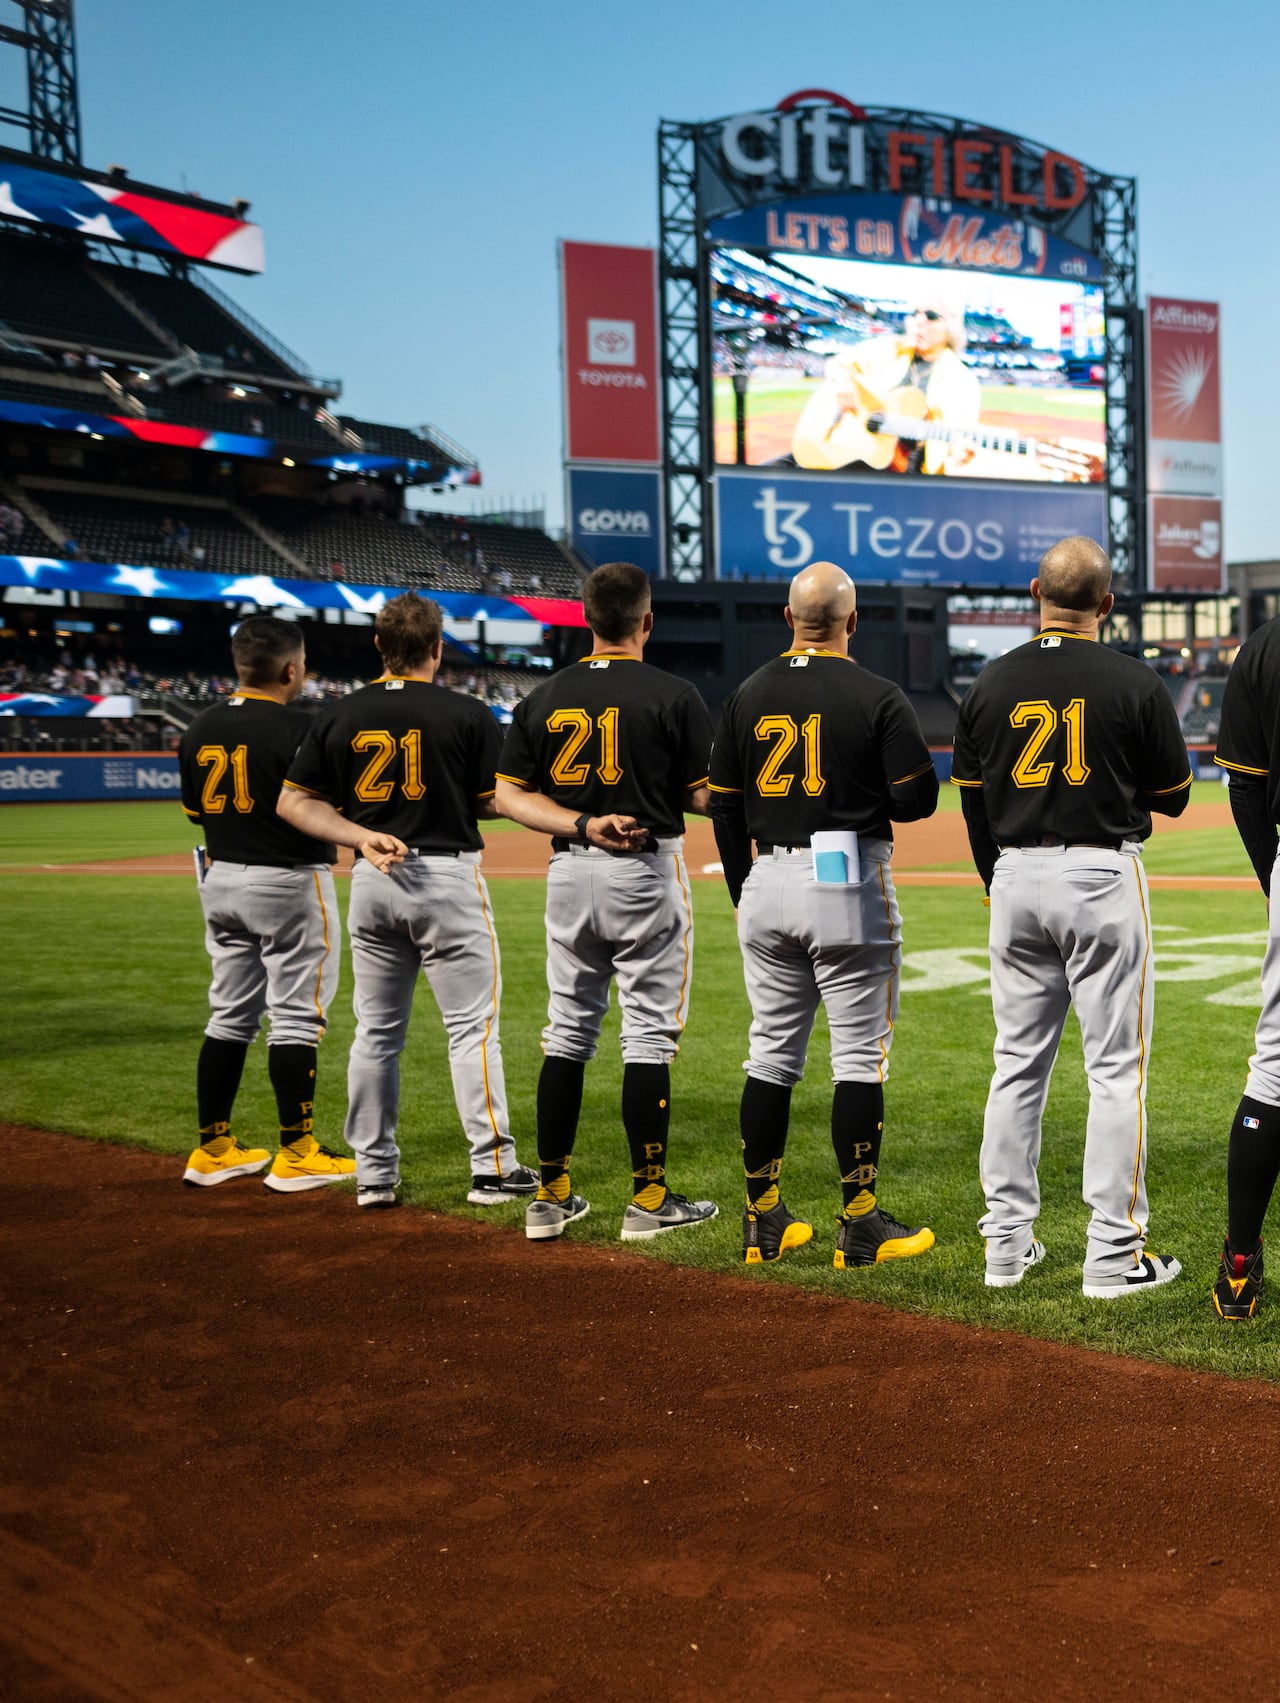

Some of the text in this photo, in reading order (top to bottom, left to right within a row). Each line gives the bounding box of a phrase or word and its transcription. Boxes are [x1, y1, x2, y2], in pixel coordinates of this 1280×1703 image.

[721, 104, 1088, 210] citi FIELD
[767, 210, 1023, 270] LET'S GO Mets
[1151, 305, 1217, 333] Affinity
[578, 369, 647, 389] TOYOTA
[579, 509, 649, 533] GOYA
[832, 502, 1005, 561] Tezos
[351, 728, 427, 803] 21
[545, 706, 624, 786] 21
[753, 713, 827, 798] 21
[1008, 698, 1092, 789] 21
[196, 744, 255, 814] 21
[853, 1141, 872, 1159] P
